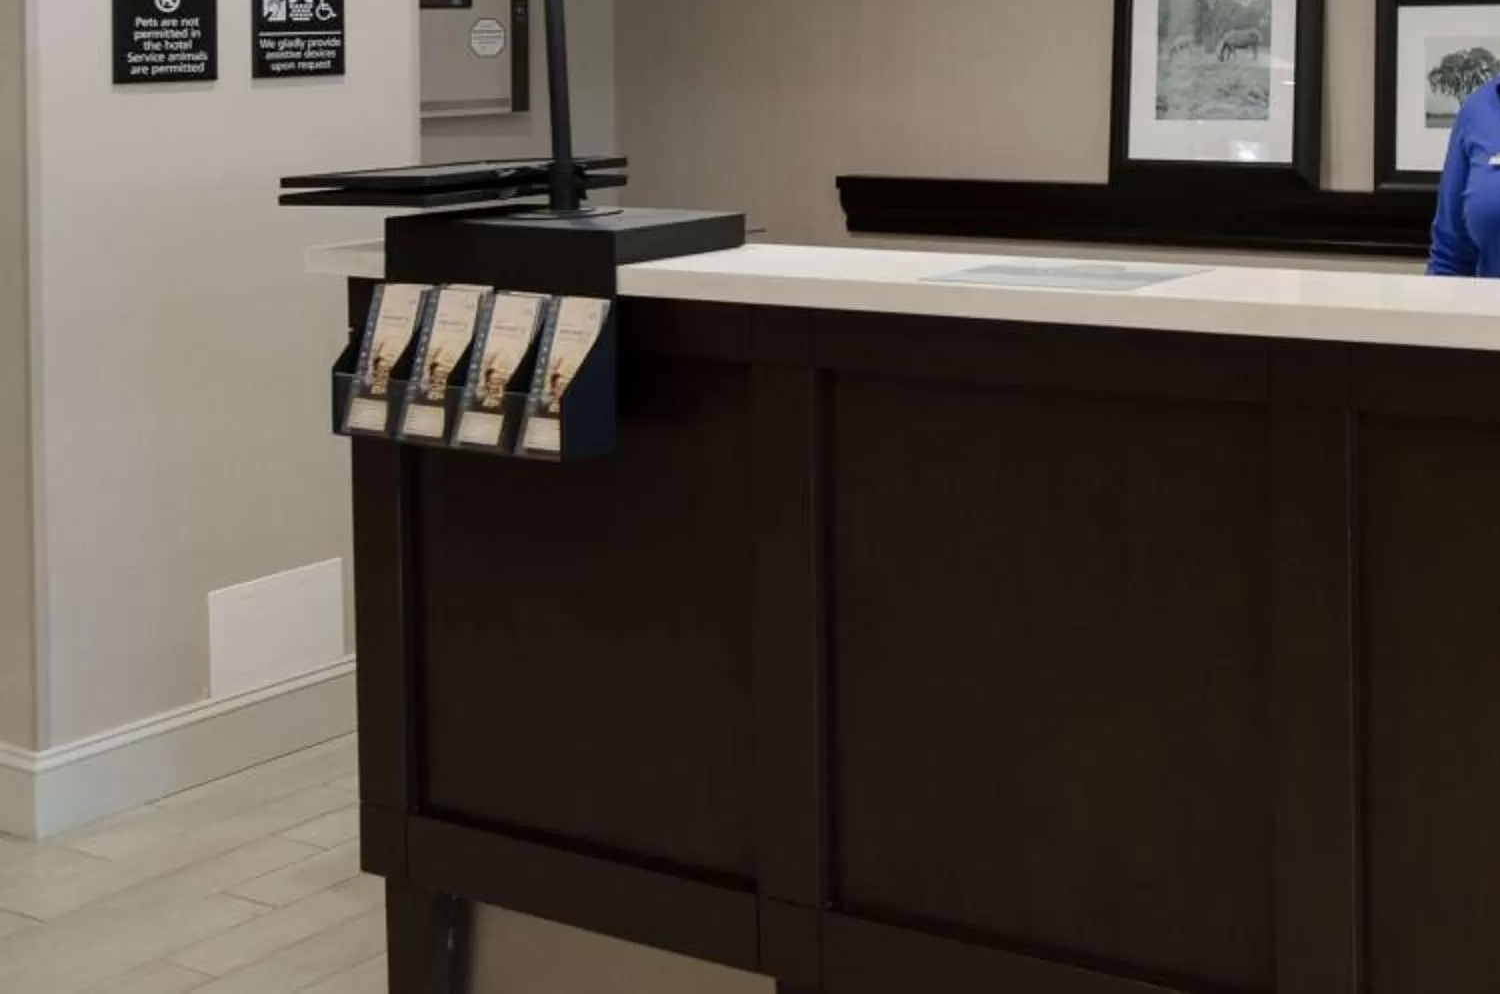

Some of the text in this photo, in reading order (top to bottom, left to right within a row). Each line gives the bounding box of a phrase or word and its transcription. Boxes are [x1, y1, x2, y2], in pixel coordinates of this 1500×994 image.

[134, 16, 200, 28] Pets are not
[133, 28, 189, 41] permitted
[143, 39, 193, 51] the hotel
[259, 38, 276, 49] We
[306, 36, 341, 53] provide
[127, 50, 209, 63] Service animals
[130, 61, 205, 76] are permitted
